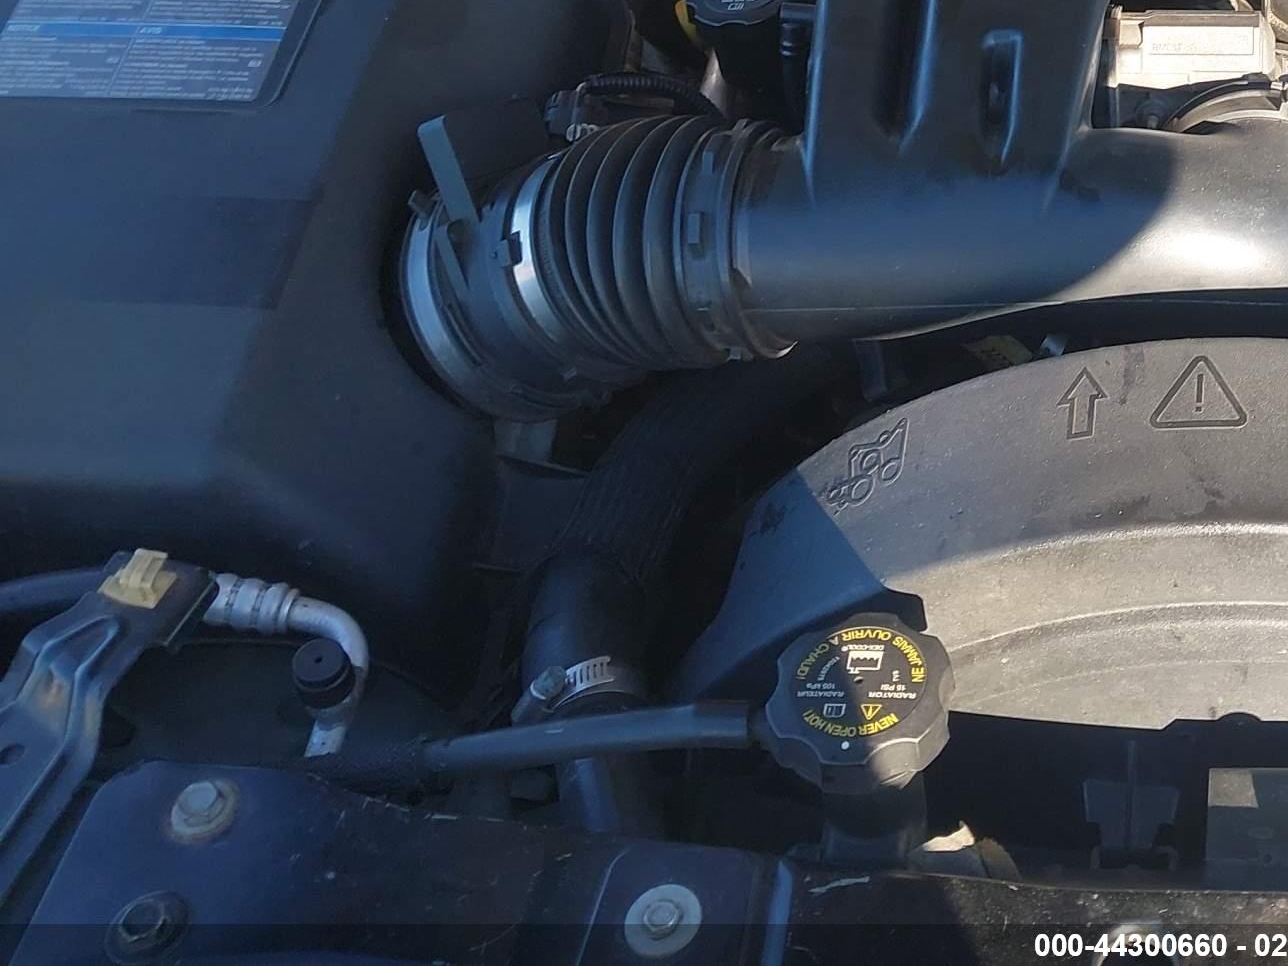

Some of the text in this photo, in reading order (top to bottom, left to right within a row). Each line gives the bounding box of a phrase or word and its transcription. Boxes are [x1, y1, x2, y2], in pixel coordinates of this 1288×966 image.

[841, 628, 892, 642] OUVRIR
[891, 635, 923, 669] JAMAIS
[795, 642, 830, 681] CHAUD!
[912, 667, 925, 682] NE
[796, 690, 845, 698] RADIATEUR
[868, 691, 916, 699] RADIATOR
[801, 709, 899, 738] NEVER OPEN HOT!
